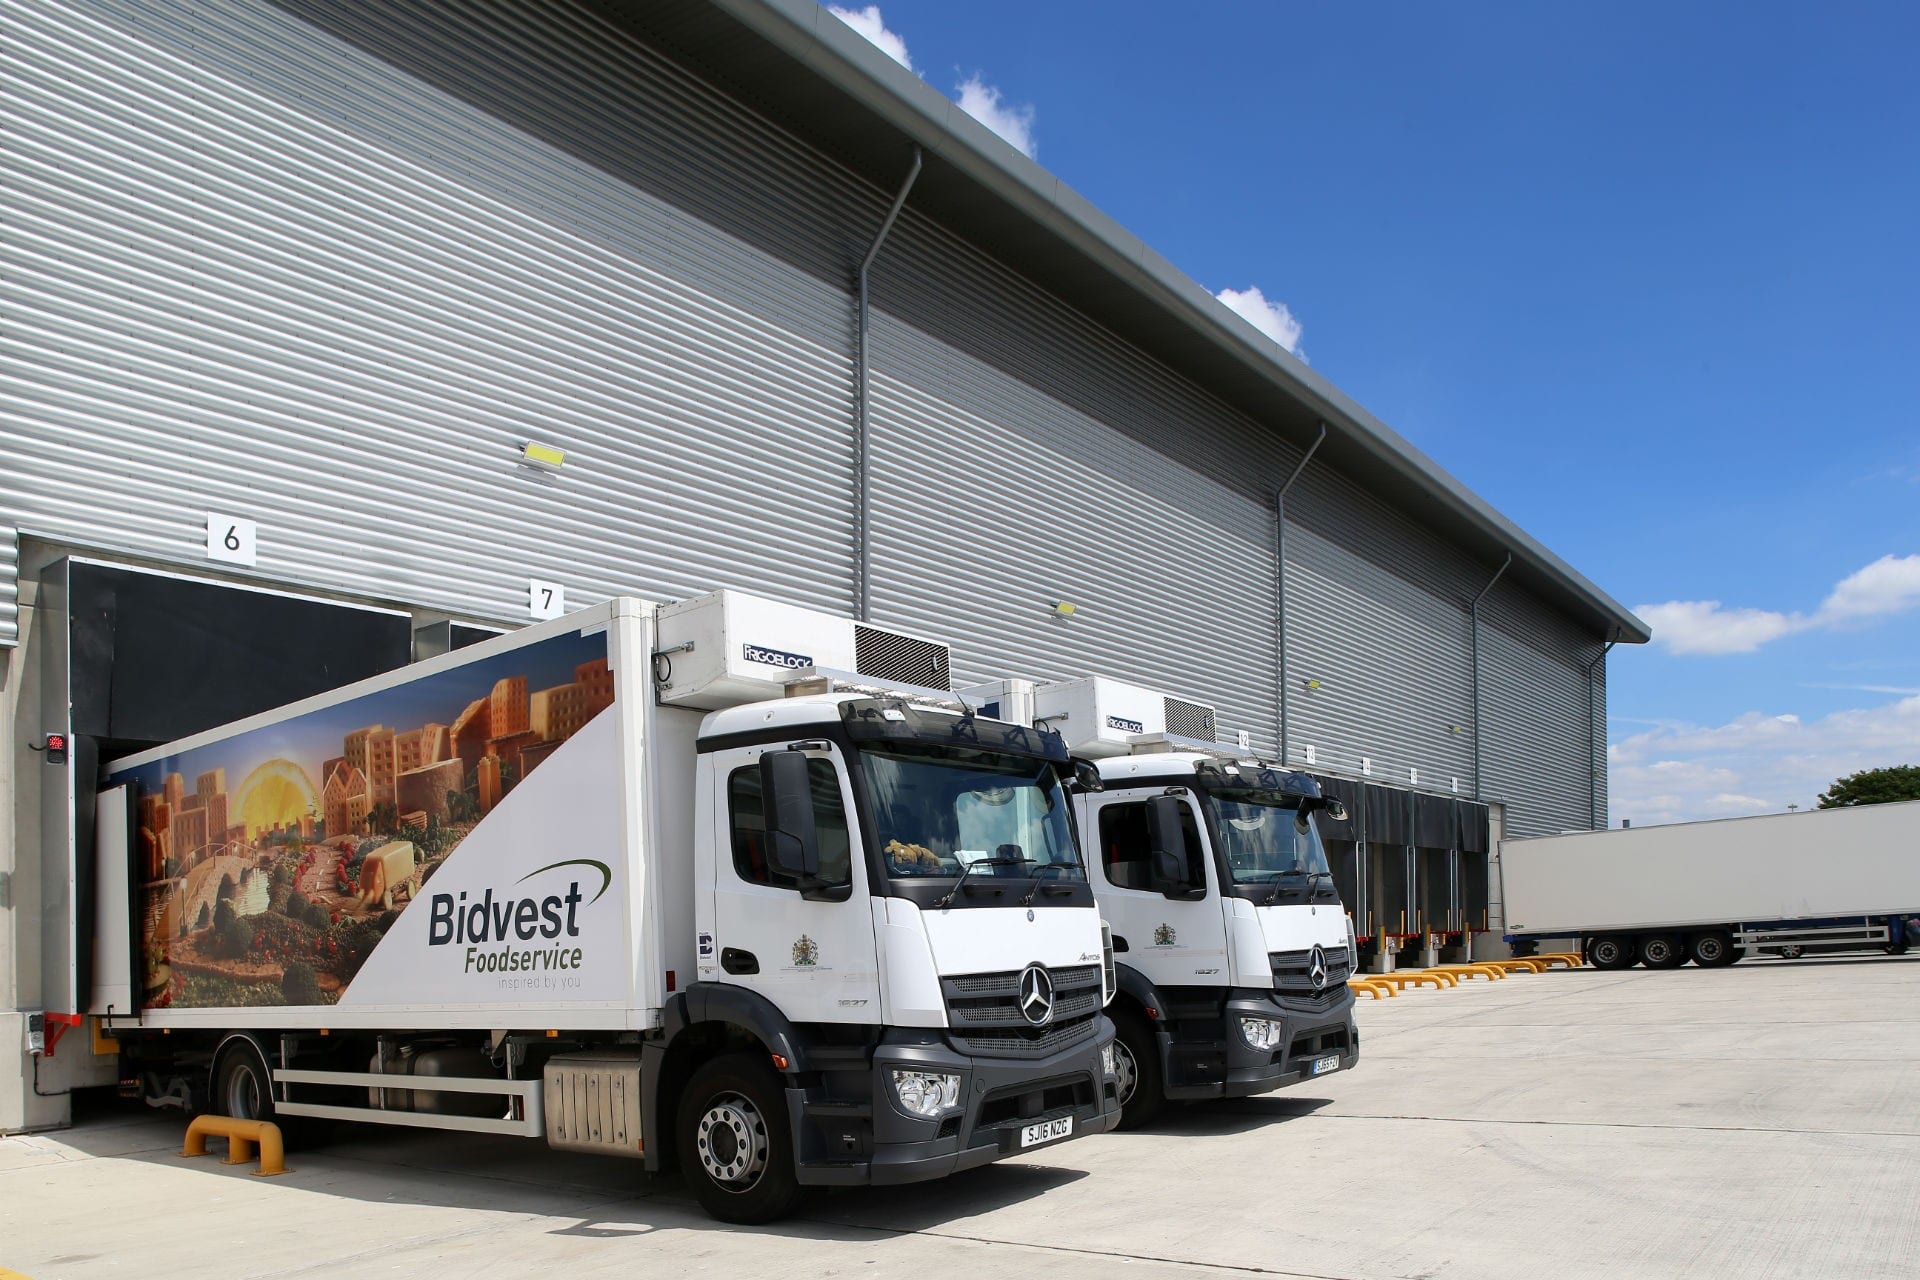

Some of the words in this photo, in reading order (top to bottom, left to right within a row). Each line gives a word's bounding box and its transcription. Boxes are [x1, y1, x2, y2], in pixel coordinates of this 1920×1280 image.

[225, 525, 240, 551] 6
[541, 588, 553, 610] 7
[743, 644, 813, 669] FRIGOBLOCK
[429, 882, 583, 946] Bidvest
[464, 942, 582, 974] Foodservice
[498, 976, 540, 991] inspired
[544, 976, 557, 991] by
[561, 976, 582, 991] you
[1028, 1123, 1049, 1142] SJ16
[1050, 1119, 1067, 1137] NZG
